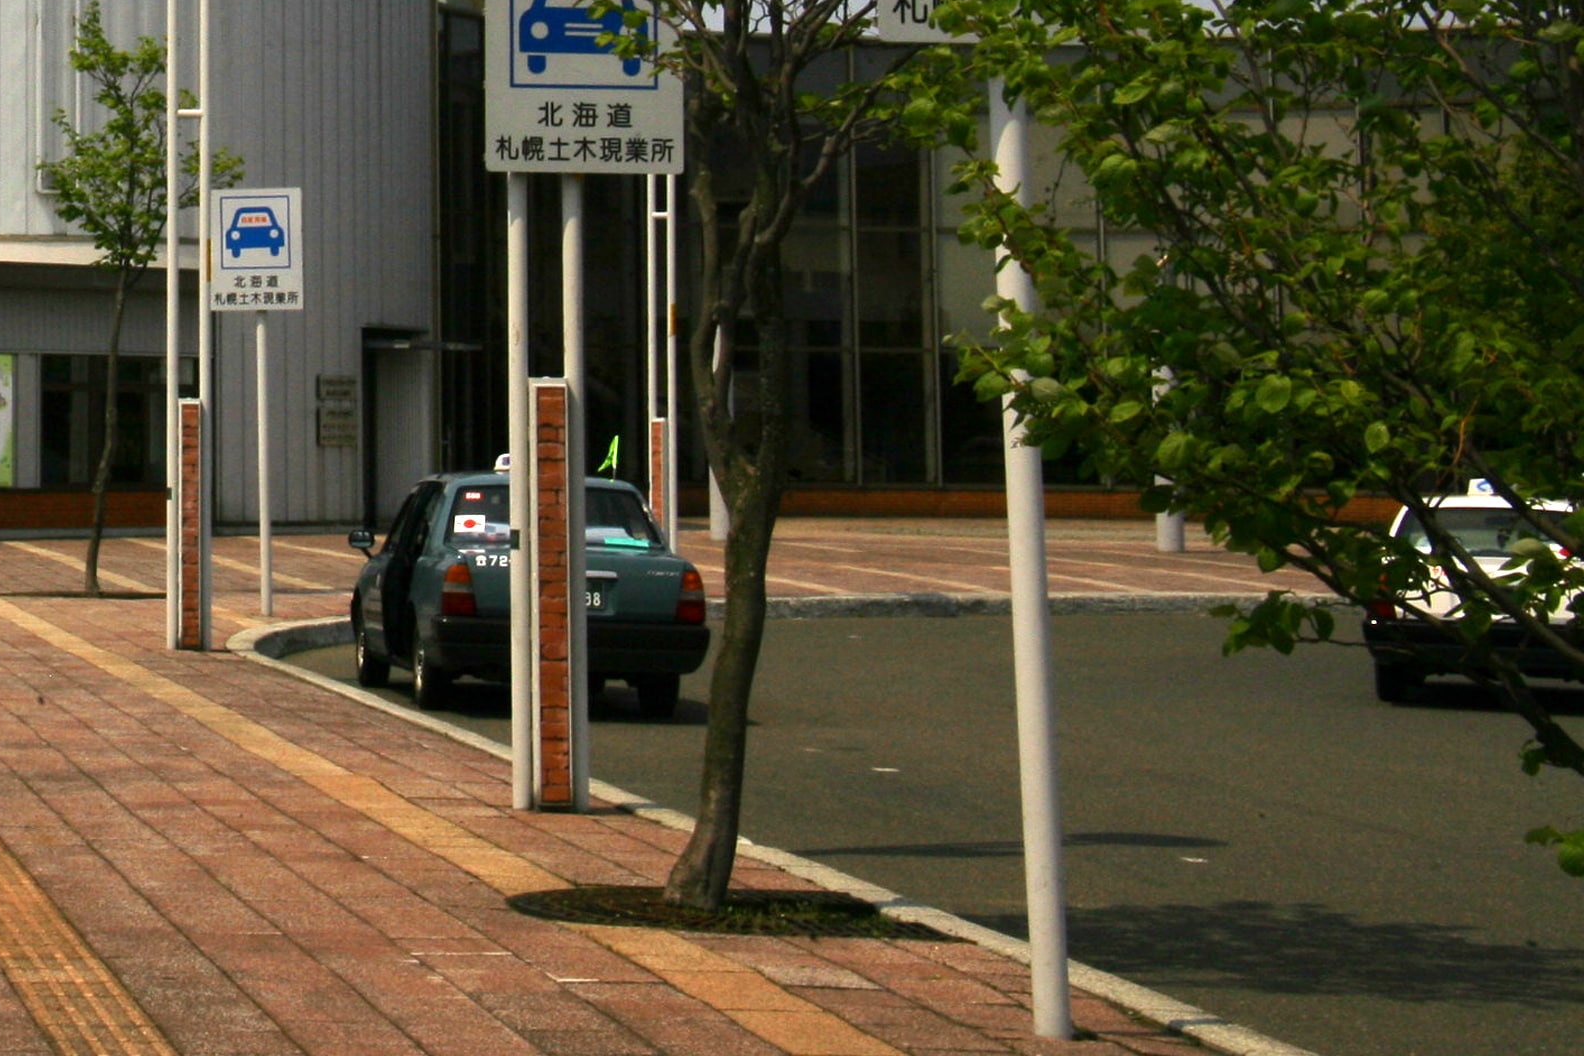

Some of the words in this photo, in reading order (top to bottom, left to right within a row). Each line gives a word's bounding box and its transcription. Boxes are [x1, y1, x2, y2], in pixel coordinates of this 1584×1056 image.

[537, 101, 633, 128] 北海道
[495, 136, 675, 163] 札幌土木現業所
[234, 275, 279, 288] 北海道
